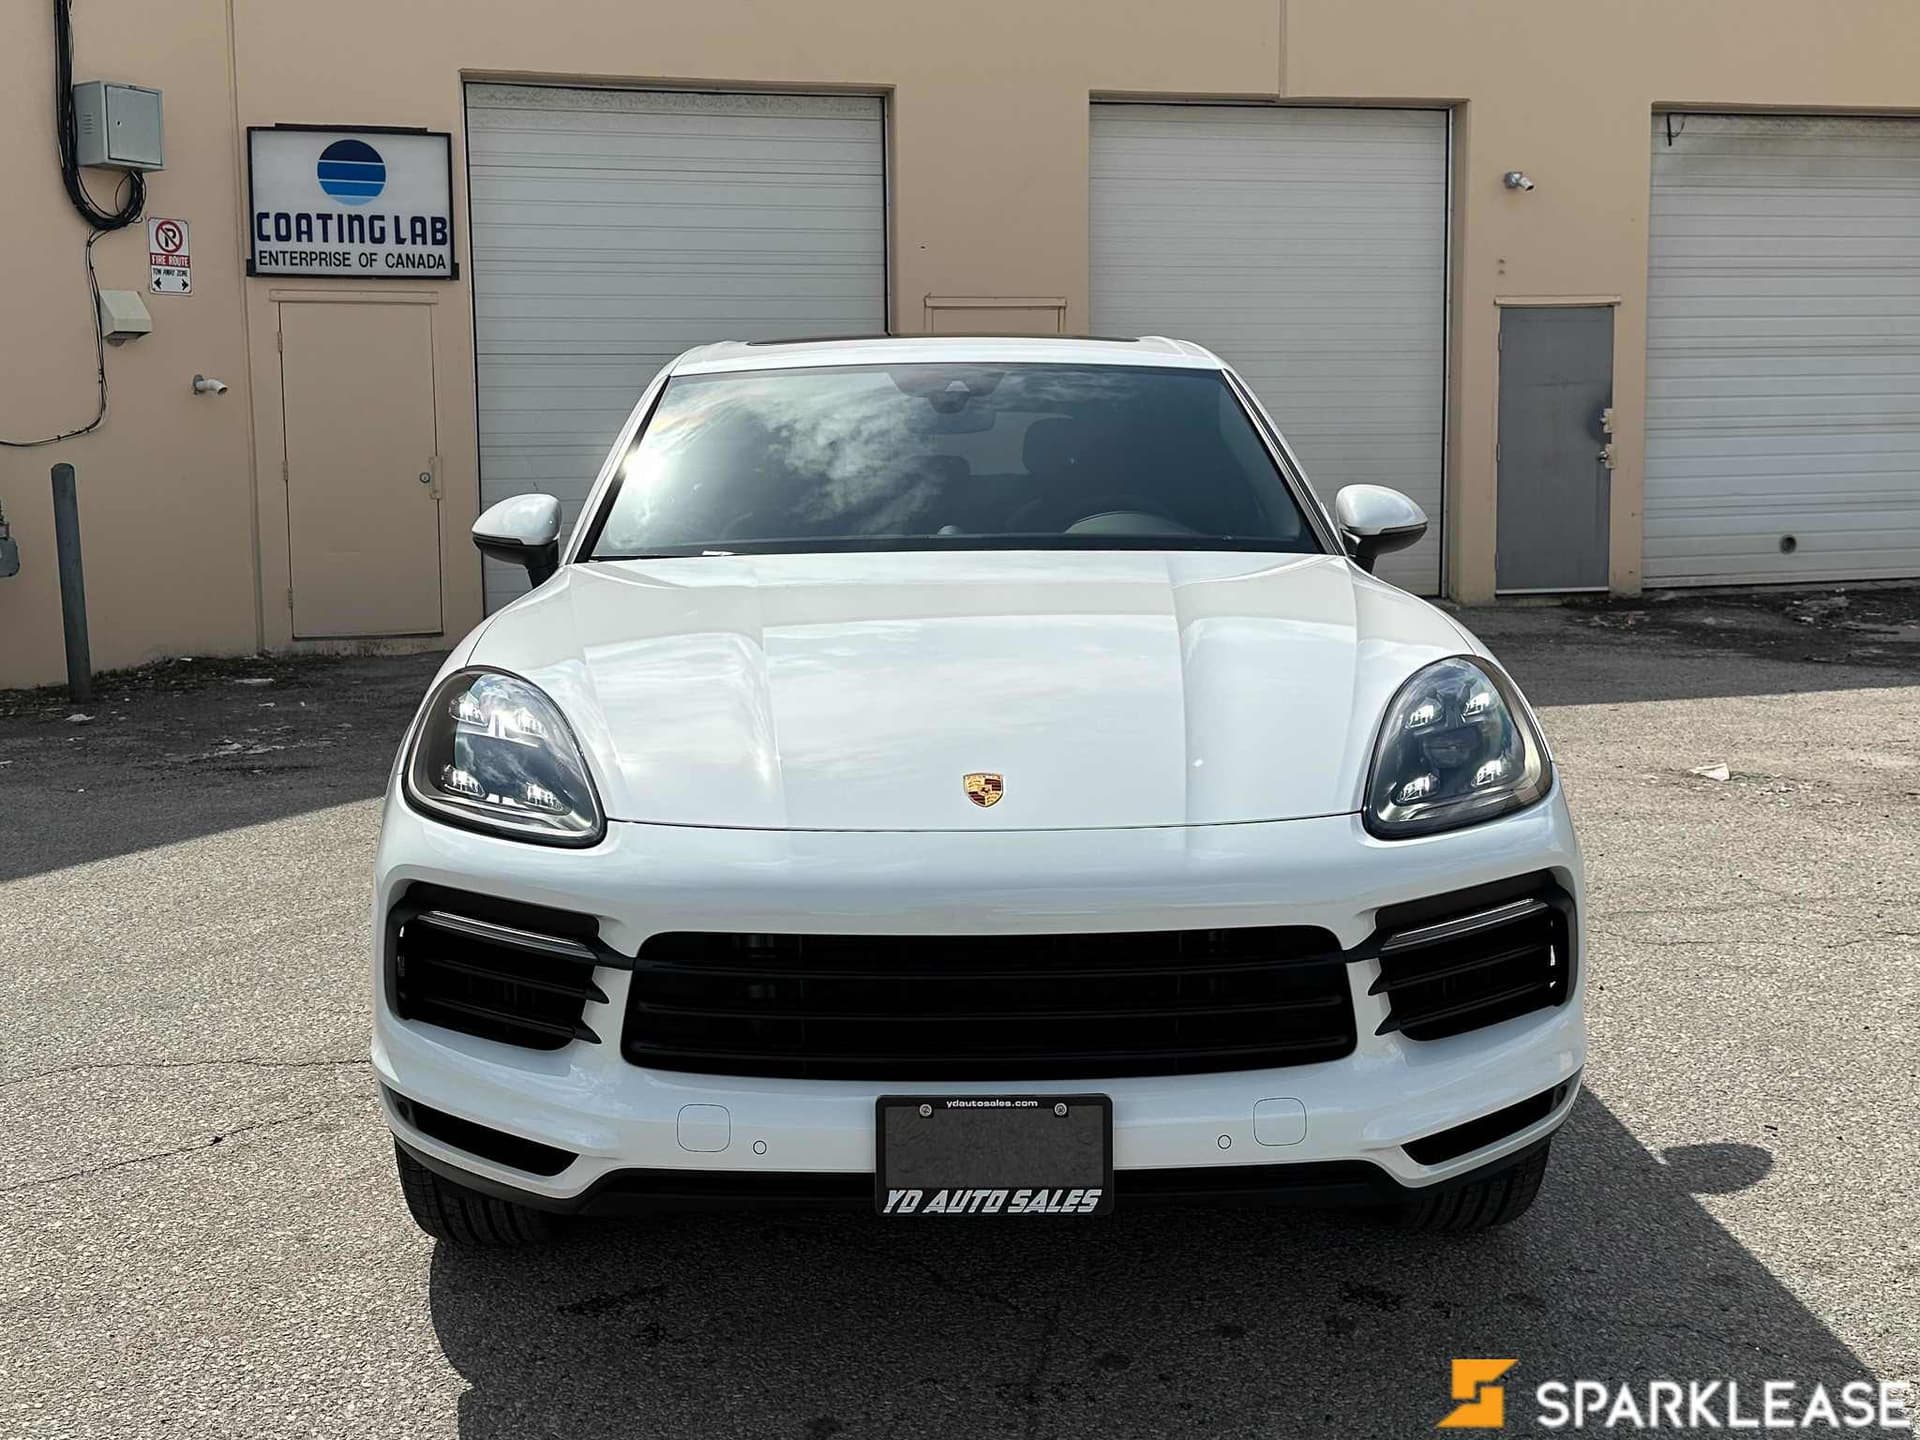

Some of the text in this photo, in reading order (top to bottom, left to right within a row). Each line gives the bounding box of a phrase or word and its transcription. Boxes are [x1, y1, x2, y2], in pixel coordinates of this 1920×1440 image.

[256, 212, 448, 245] COATING LAB
[152, 255, 189, 267] FIRE ROUTE
[259, 250, 446, 269] ENTERPRISE OF CANADA
[946, 1099, 1038, 1108] ydautosales.com
[883, 1190, 1102, 1213] YD AUTO SALES
